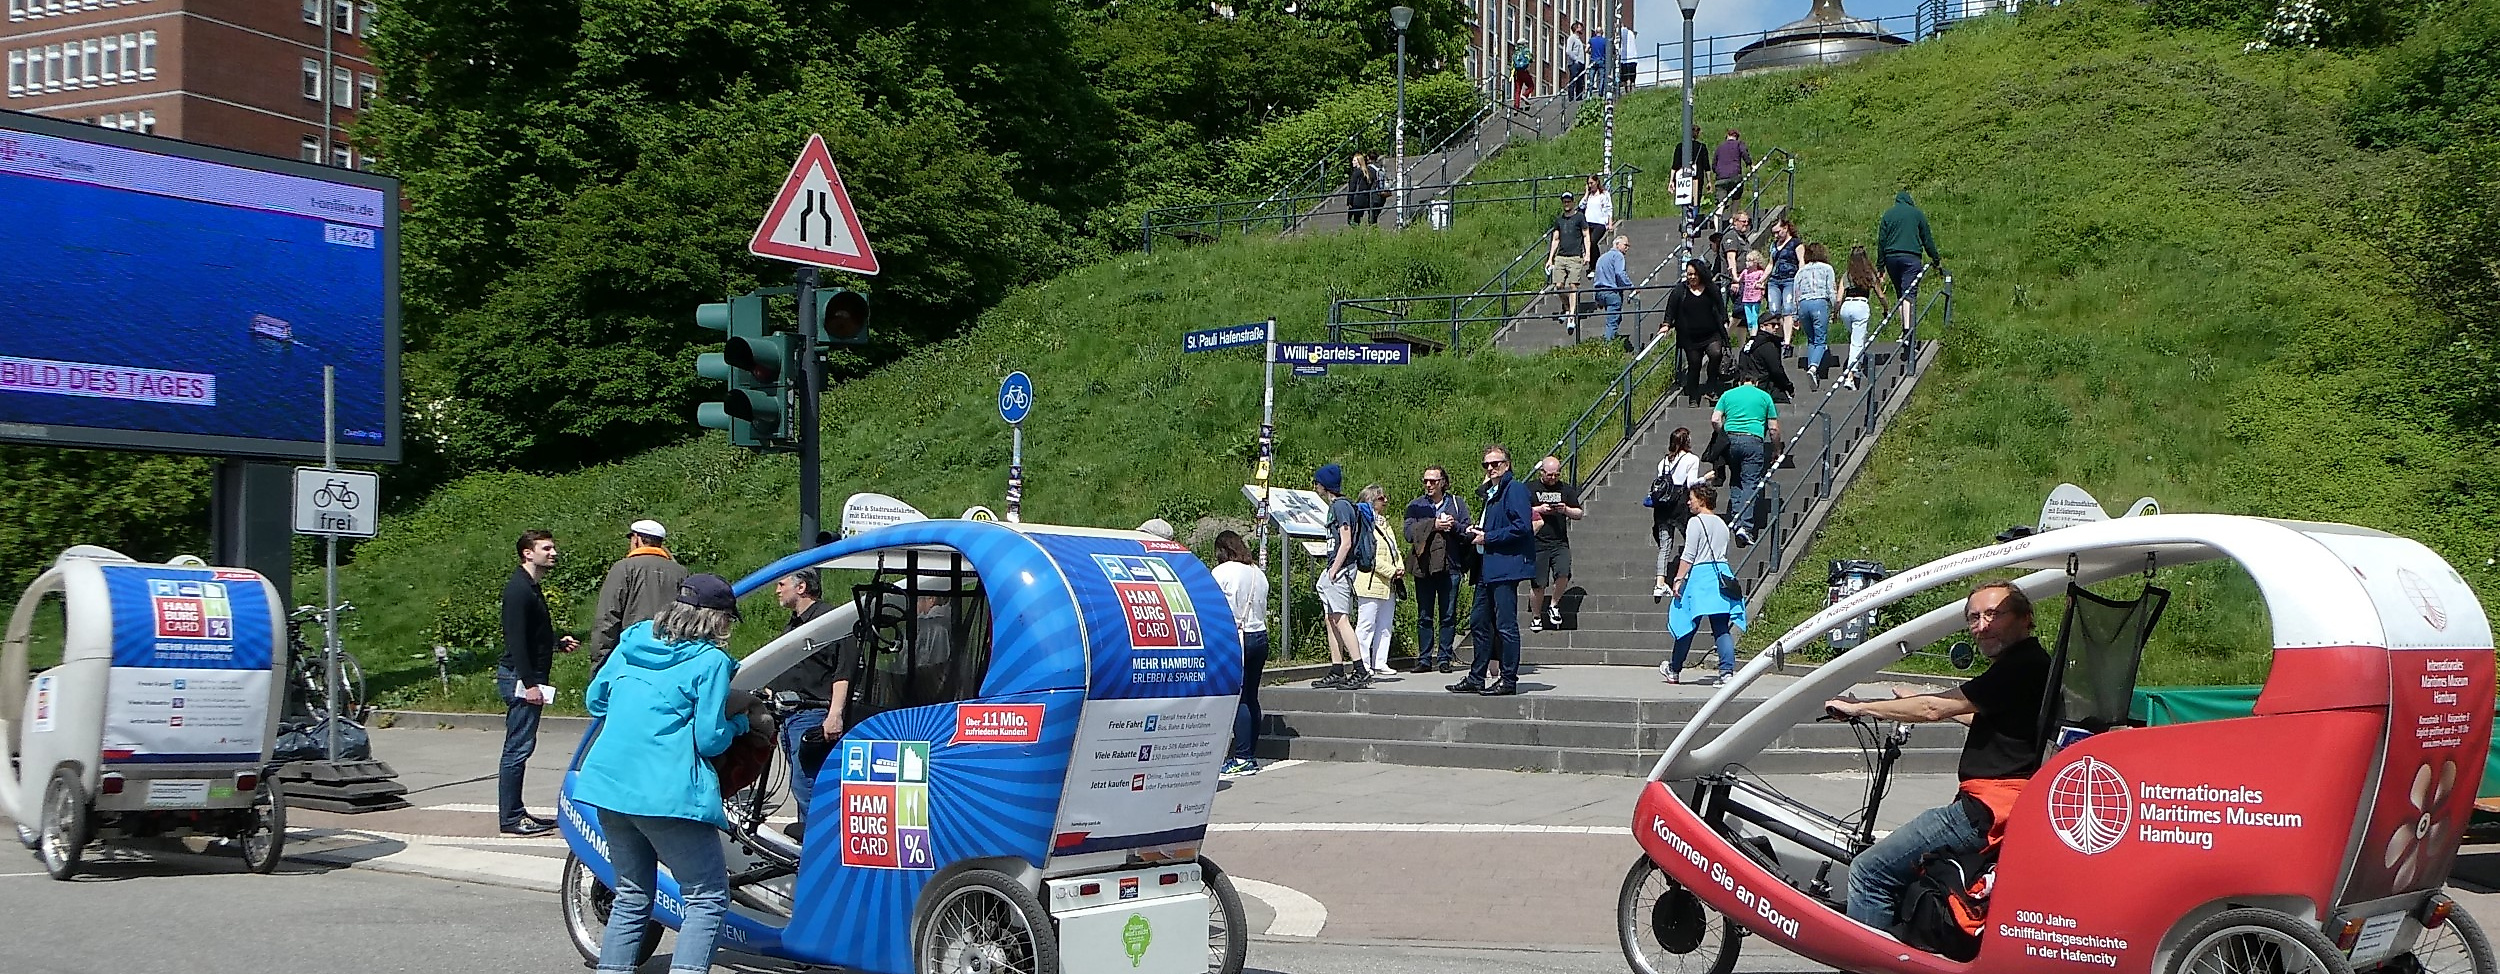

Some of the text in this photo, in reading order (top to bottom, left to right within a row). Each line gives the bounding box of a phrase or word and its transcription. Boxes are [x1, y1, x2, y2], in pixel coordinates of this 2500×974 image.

[1677, 180, 1691, 188] WC
[329, 227, 370, 246] 12:42
[1187, 326, 1265, 349] St. Pauli Hafenstraße
[1, 362, 205, 399] BILD DES TAGES
[860, 513, 901, 522] Erläuterungen
[870, 506, 916, 514] Stadtrundfahrten
[320, 512, 352, 531] frei
[1124, 589, 1160, 605] HAM
[1132, 605, 1166, 621] BURG
[1137, 622, 1170, 638] CARD
[1179, 618, 1196, 643] %
[1132, 657, 1205, 670] MEHR HAMBURG
[1132, 671, 1206, 684] ERLEBEN & SPAREN!
[965, 711, 1028, 727] Über 11 Mio.
[1108, 719, 1143, 730] Freie Fahrt
[964, 727, 1028, 736] zufriedene Kunden!
[1094, 750, 1111, 760] Viele
[1111, 750, 1137, 759] Rabatte
[1090, 779, 1130, 790] Jetzt kaufen
[2138, 781, 2263, 805] Internationales
[849, 794, 888, 815] HAM
[849, 815, 888, 835] BURG
[2138, 803, 2303, 828] Maritimes Museum
[849, 836, 889, 857] CARD
[2138, 824, 2214, 850] Hamburg
[904, 834, 926, 864] %
[1652, 814, 1800, 940] Kommen Sie an Bord!
[655, 888, 685, 921] EBEN
[2015, 910, 2077, 929] 3000 Jahre
[722, 922, 748, 945] EN!
[1999, 924, 2128, 951] Schifffahrtsgeschichte
[2026, 943, 2118, 968] in der Hafencity
